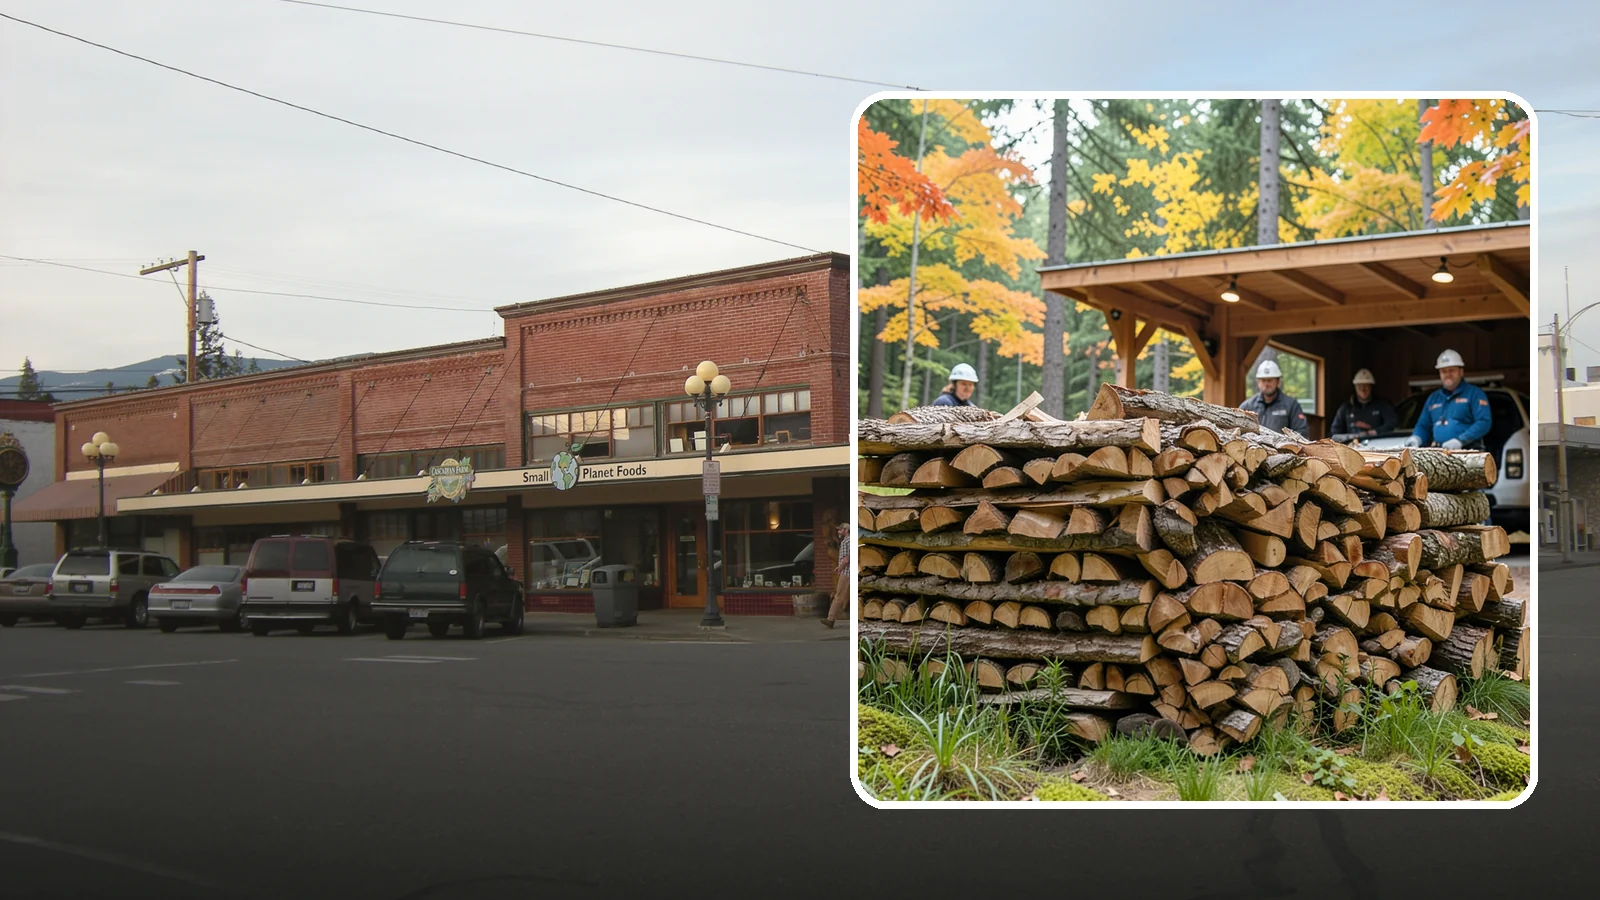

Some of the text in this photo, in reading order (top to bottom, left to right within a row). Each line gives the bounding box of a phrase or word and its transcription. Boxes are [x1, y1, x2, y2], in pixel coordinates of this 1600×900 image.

[431, 466, 469, 476] CASCADIAN FARM
[523, 464, 647, 483] Small Planet Foods
